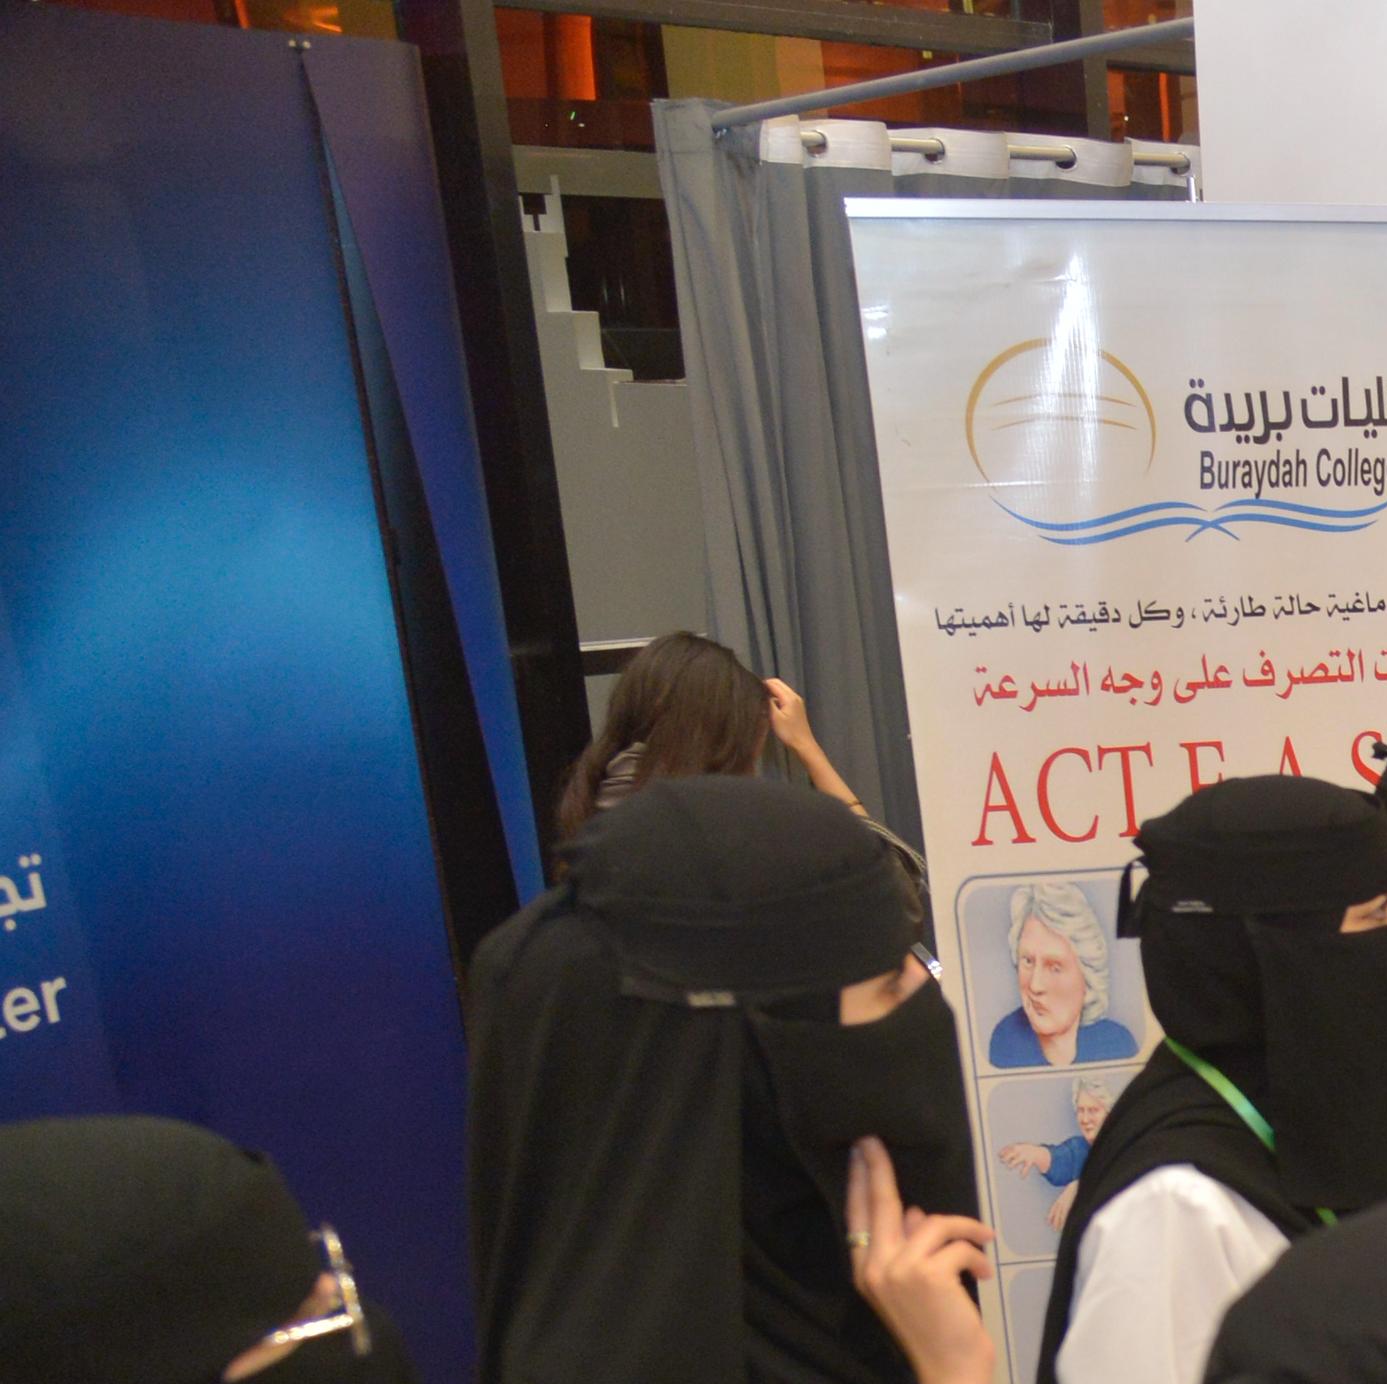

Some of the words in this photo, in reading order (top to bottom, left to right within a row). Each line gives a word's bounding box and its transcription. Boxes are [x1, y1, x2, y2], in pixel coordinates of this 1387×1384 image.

[1184, 378, 1293, 445] بريدة
[1199, 449, 1308, 500] Buraydah
[935, 602, 1016, 637] أهميتها
[1021, 603, 1051, 634] لها
[1058, 602, 1122, 632] دقيقة
[1128, 599, 1185, 629] وكل
[1273, 594, 1321, 620] حالة
[973, 660, 1091, 713] السرعة
[1100, 665, 1164, 706] وجه
[1173, 653, 1233, 704] على
[1242, 648, 1364, 700] التصرف
[970, 741, 1154, 847] ACT
